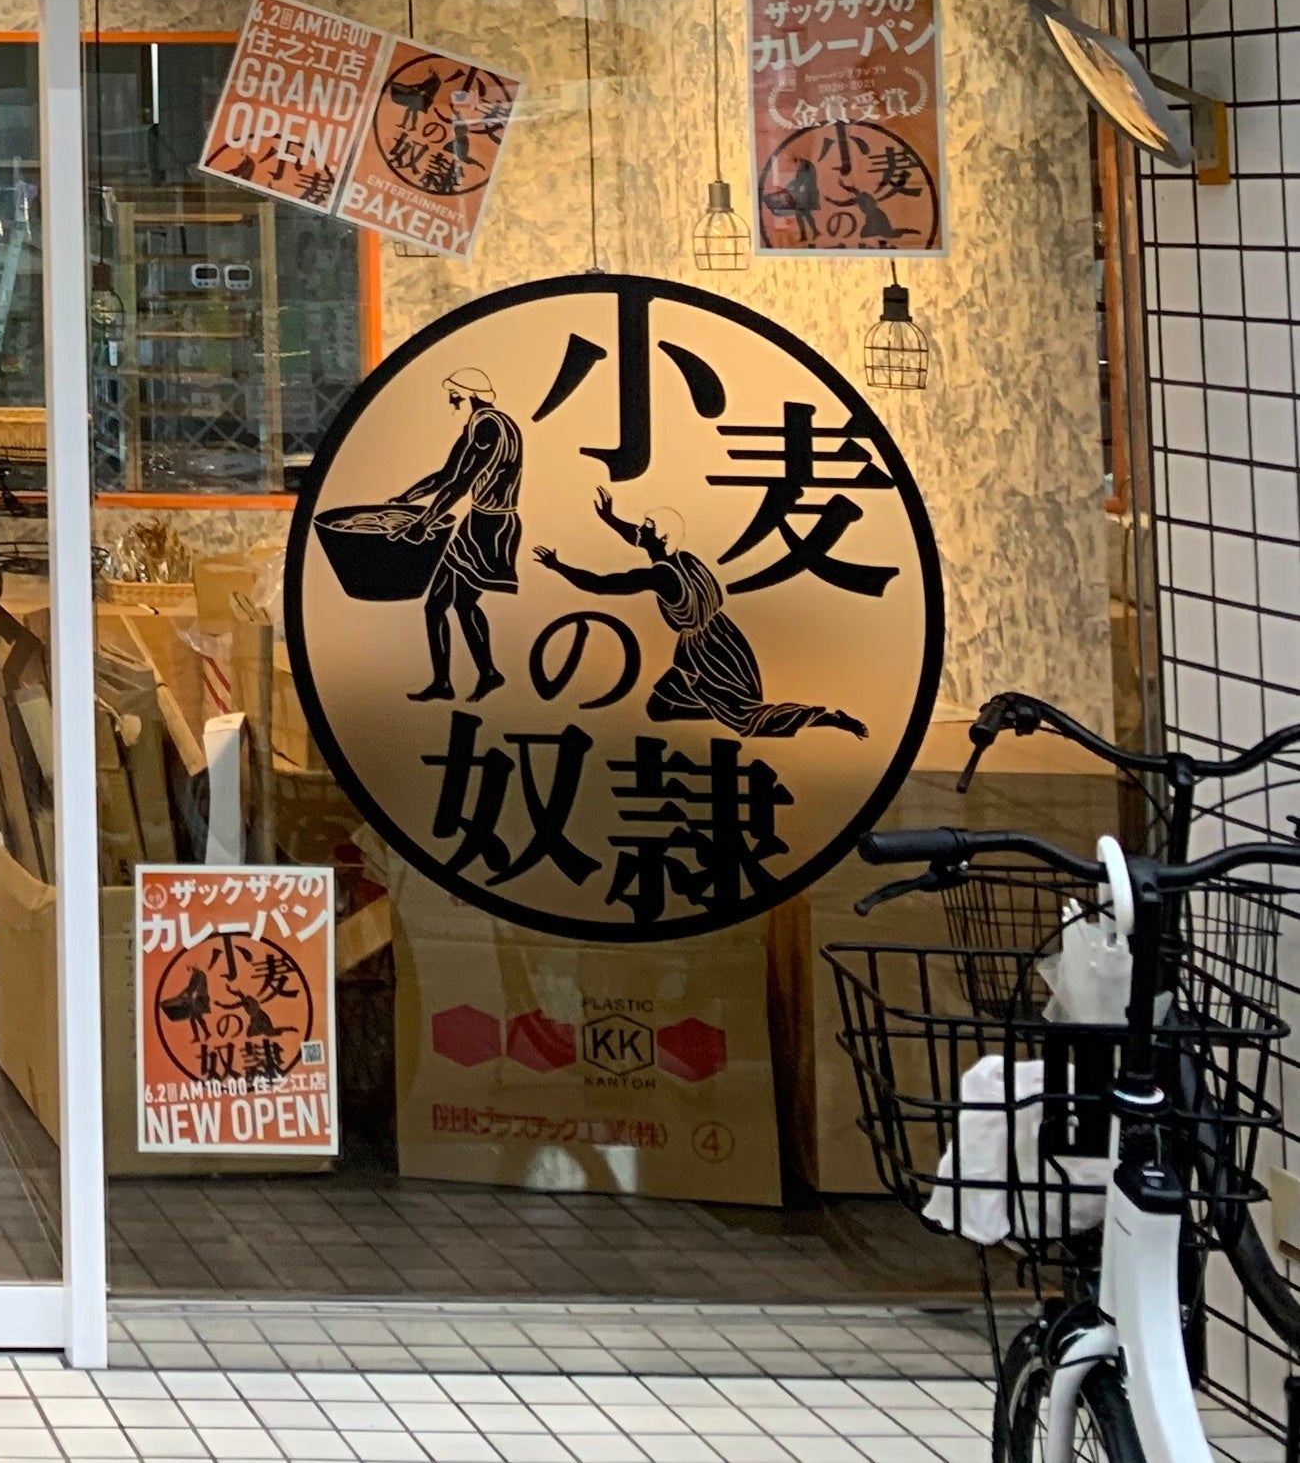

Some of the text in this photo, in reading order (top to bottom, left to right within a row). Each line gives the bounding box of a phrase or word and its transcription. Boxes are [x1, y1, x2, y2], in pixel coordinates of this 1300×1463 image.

[245, 25, 367, 80] 住之江店
[752, 18, 937, 73] カレーパン
[235, 57, 358, 123] GRAND
[792, 87, 911, 128] 金賞受賞
[224, 101, 349, 175] OPEN!
[349, 182, 473, 256] BAKERY
[366, 175, 464, 223] ENTERTAINMENT
[826, 211, 858, 238] の
[528, 610, 642, 711] の
[420, 709, 796, 924] 奴隷
[170, 874, 325, 908] ザックザクの
[142, 903, 329, 954] カレーパン
[215, 1013, 244, 1038] の
[591, 1027, 643, 1062] KK
[145, 1071, 327, 1104] 6.2 AM10:00 住之江店
[145, 1093, 331, 1146] NEW OPEN!
